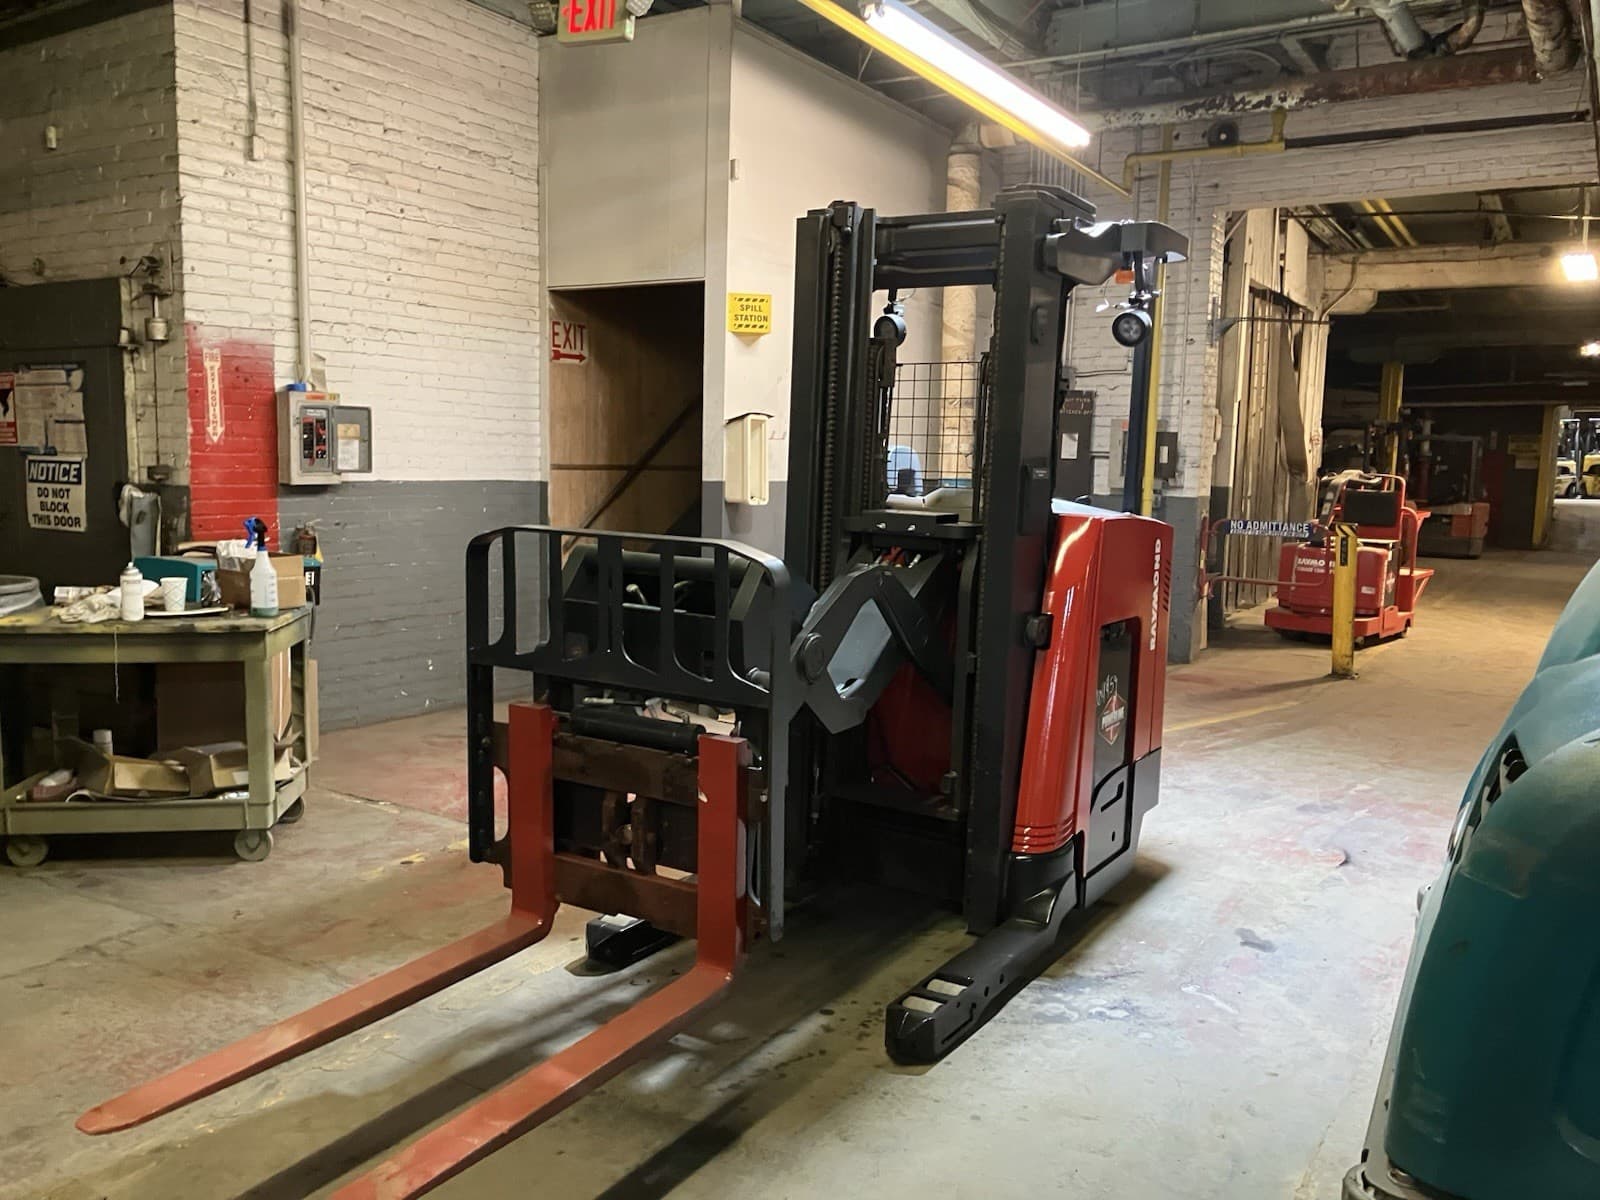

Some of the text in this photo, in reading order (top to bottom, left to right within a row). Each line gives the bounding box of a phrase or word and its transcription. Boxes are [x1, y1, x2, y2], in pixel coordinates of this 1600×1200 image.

[739, 304, 763, 313] SPILL
[734, 314, 768, 323] STATION
[551, 320, 586, 351] EXIT
[204, 351, 220, 362] FIRE
[29, 462, 80, 482] NOTICE
[37, 487, 71, 500] DO NOT
[39, 501, 70, 514] BLOCK
[32, 513, 81, 529] THIS DOOR
[1231, 520, 1244, 530] NO
[1246, 521, 1310, 533] ADMITTANCE
[1149, 538, 1161, 651] RAYMOND
